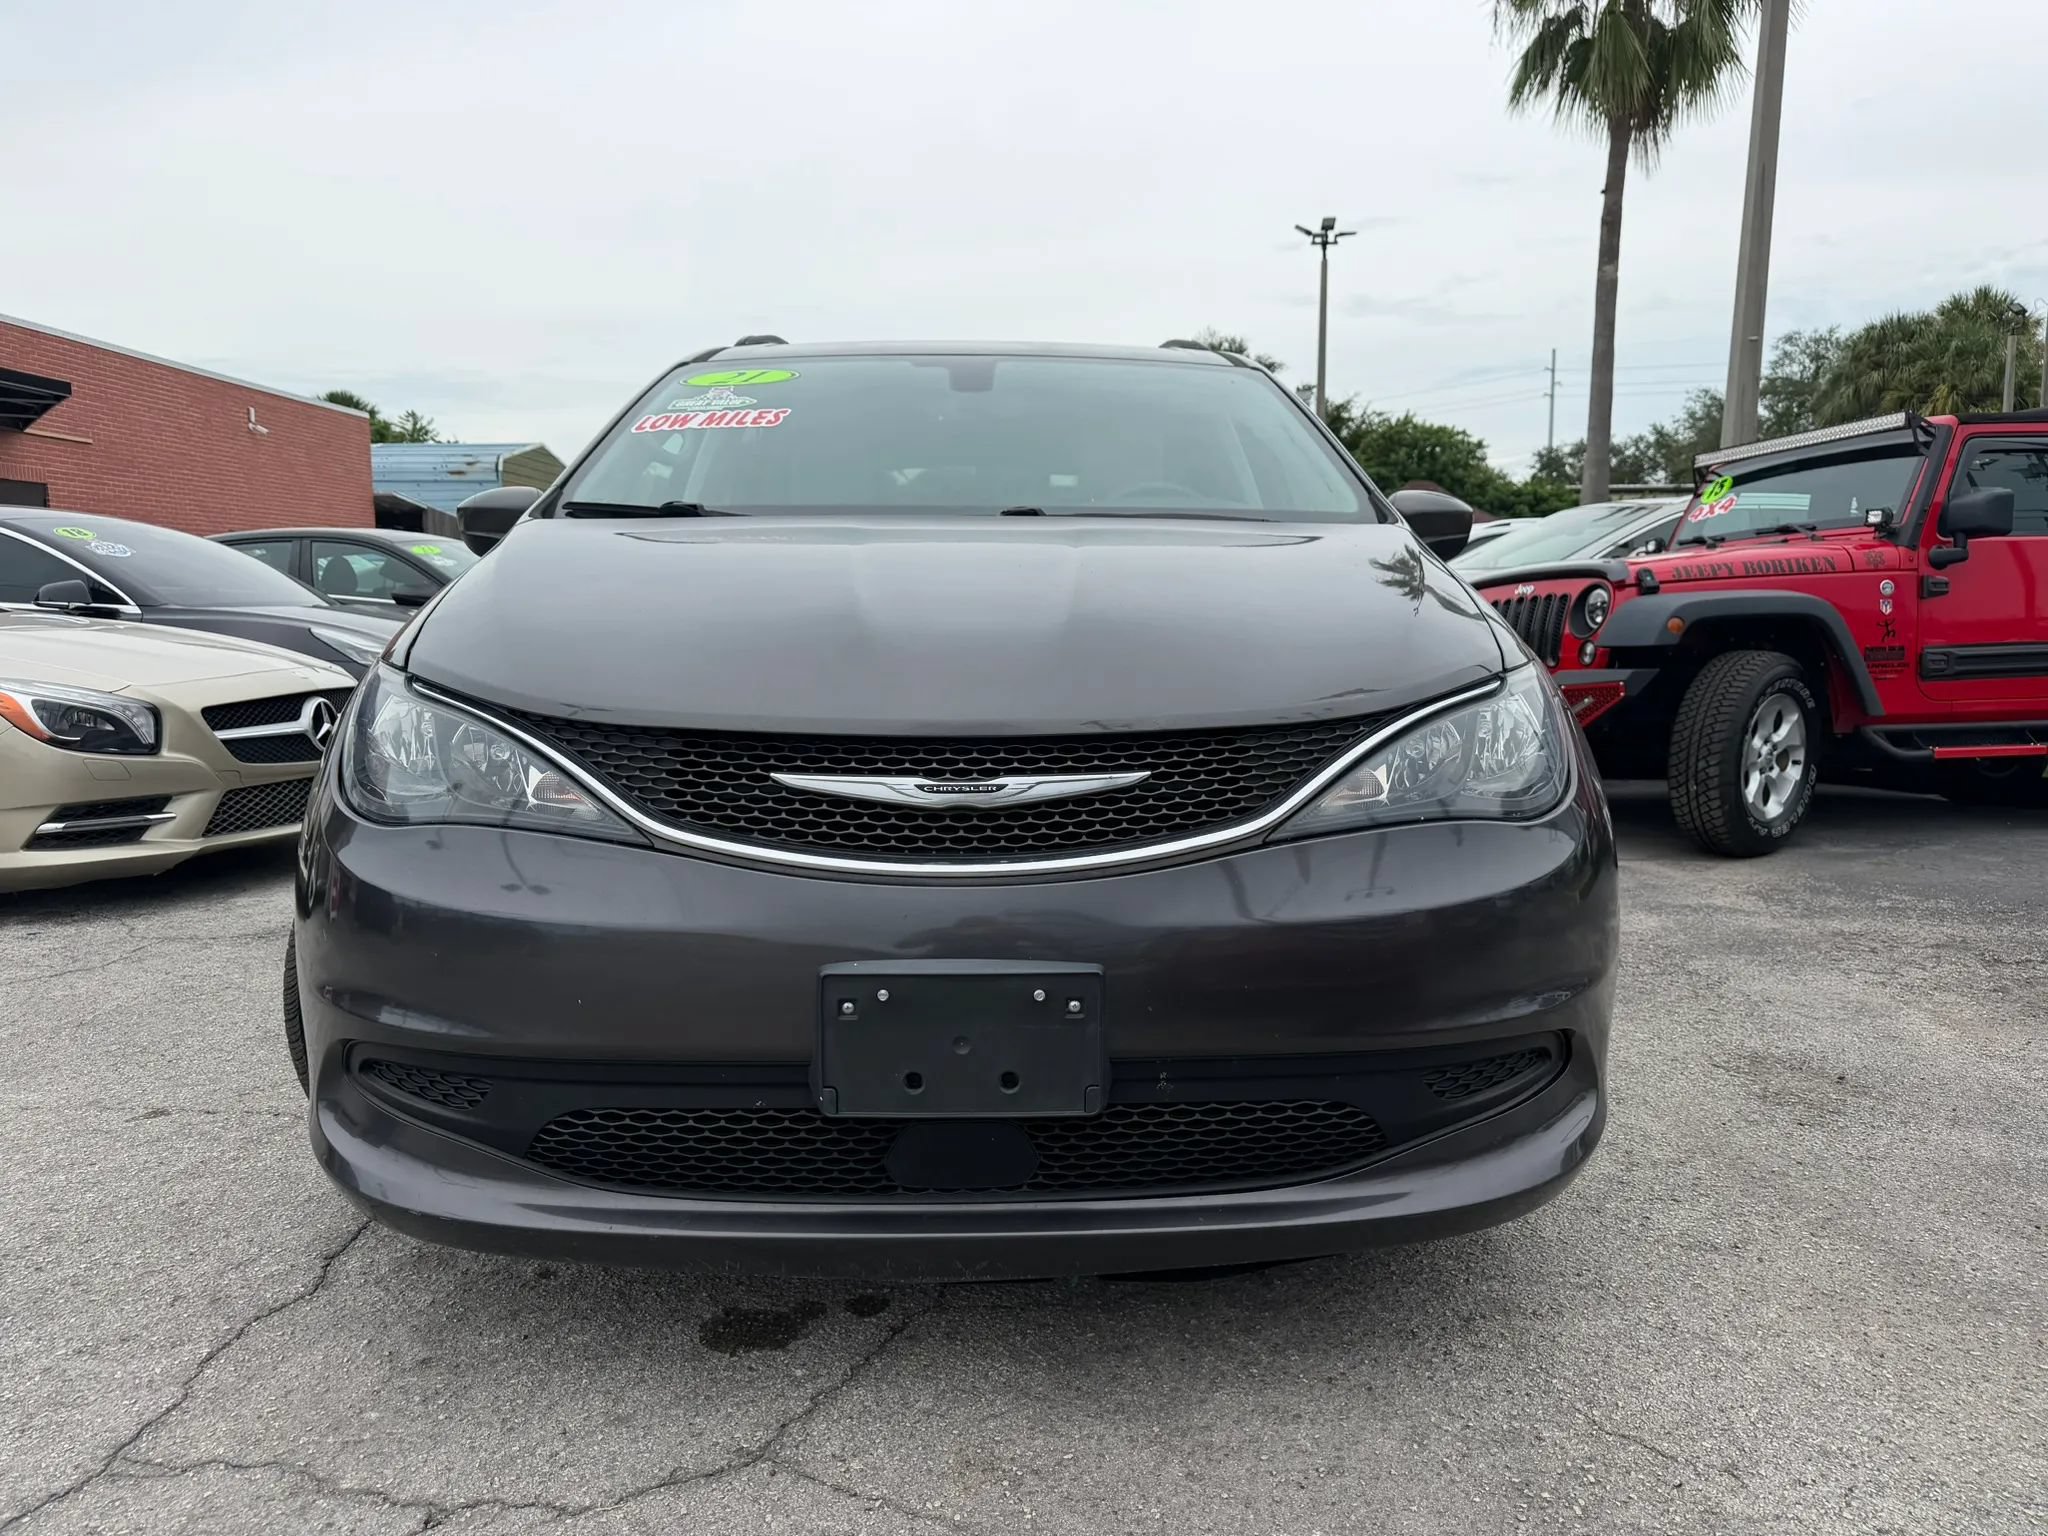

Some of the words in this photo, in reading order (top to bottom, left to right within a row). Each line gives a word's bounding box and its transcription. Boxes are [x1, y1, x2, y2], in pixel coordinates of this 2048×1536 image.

[634, 412, 699, 432] LOW
[699, 409, 790, 427] MILES
[1706, 478, 1729, 500] 15
[1672, 561, 1735, 580] JEEPY
[1743, 555, 1837, 577] BORIKEN
